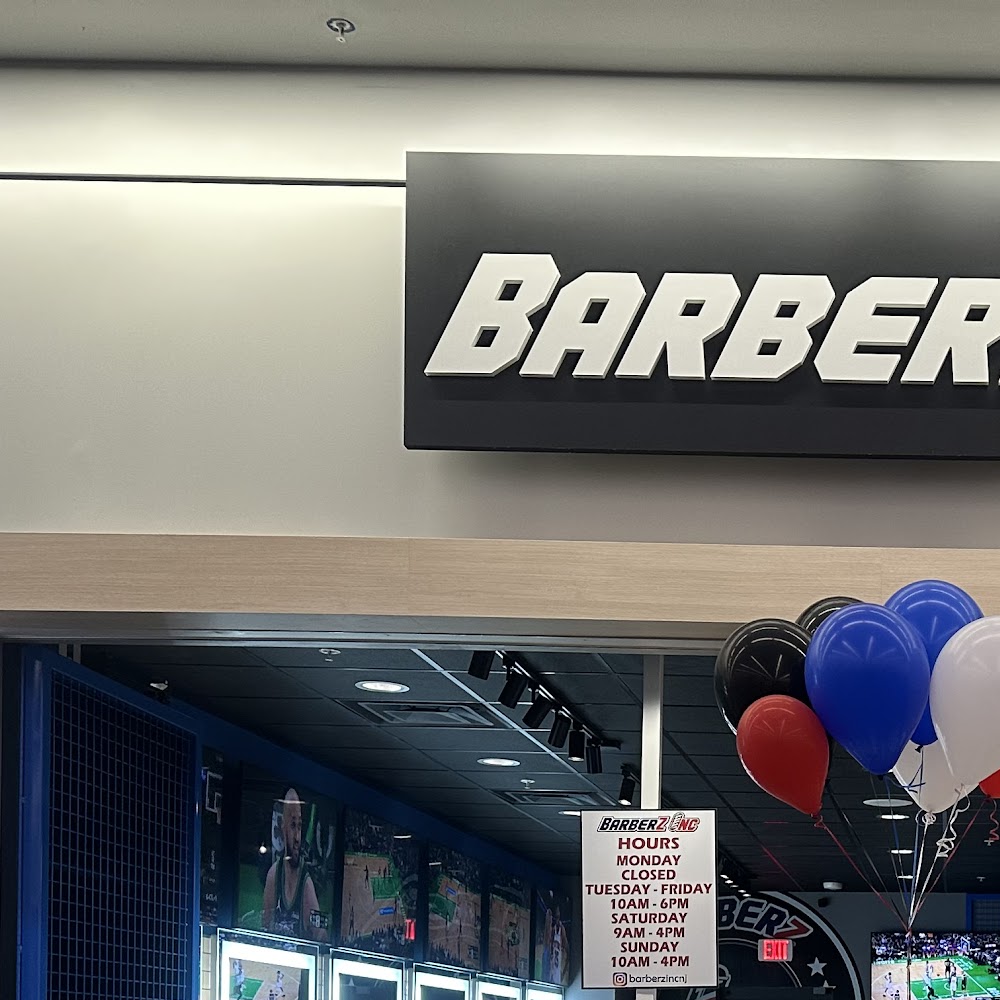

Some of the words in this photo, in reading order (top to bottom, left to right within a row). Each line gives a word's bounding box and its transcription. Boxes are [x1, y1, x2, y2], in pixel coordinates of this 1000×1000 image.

[597, 816, 670, 832] BARBERZ
[619, 838, 679, 849] HOURS
[617, 855, 681, 866] MONDAY
[622, 870, 676, 880] CLOSED
[585, 884, 651, 895] TUESDAY
[661, 884, 712, 894] FRIDAY
[611, 899, 649, 909] 10AM
[660, 898, 688, 909] 6PM
[612, 913, 687, 924] SATURDAY
[614, 928, 645, 938] 9AM
[656, 927, 684, 937] 4PM
[621, 942, 679, 953] SUNDAY
[763, 939, 790, 960] EXIT
[612, 957, 649, 967] 10AM
[661, 956, 689, 966] 4PM
[629, 974, 687, 983] barberzincnj
